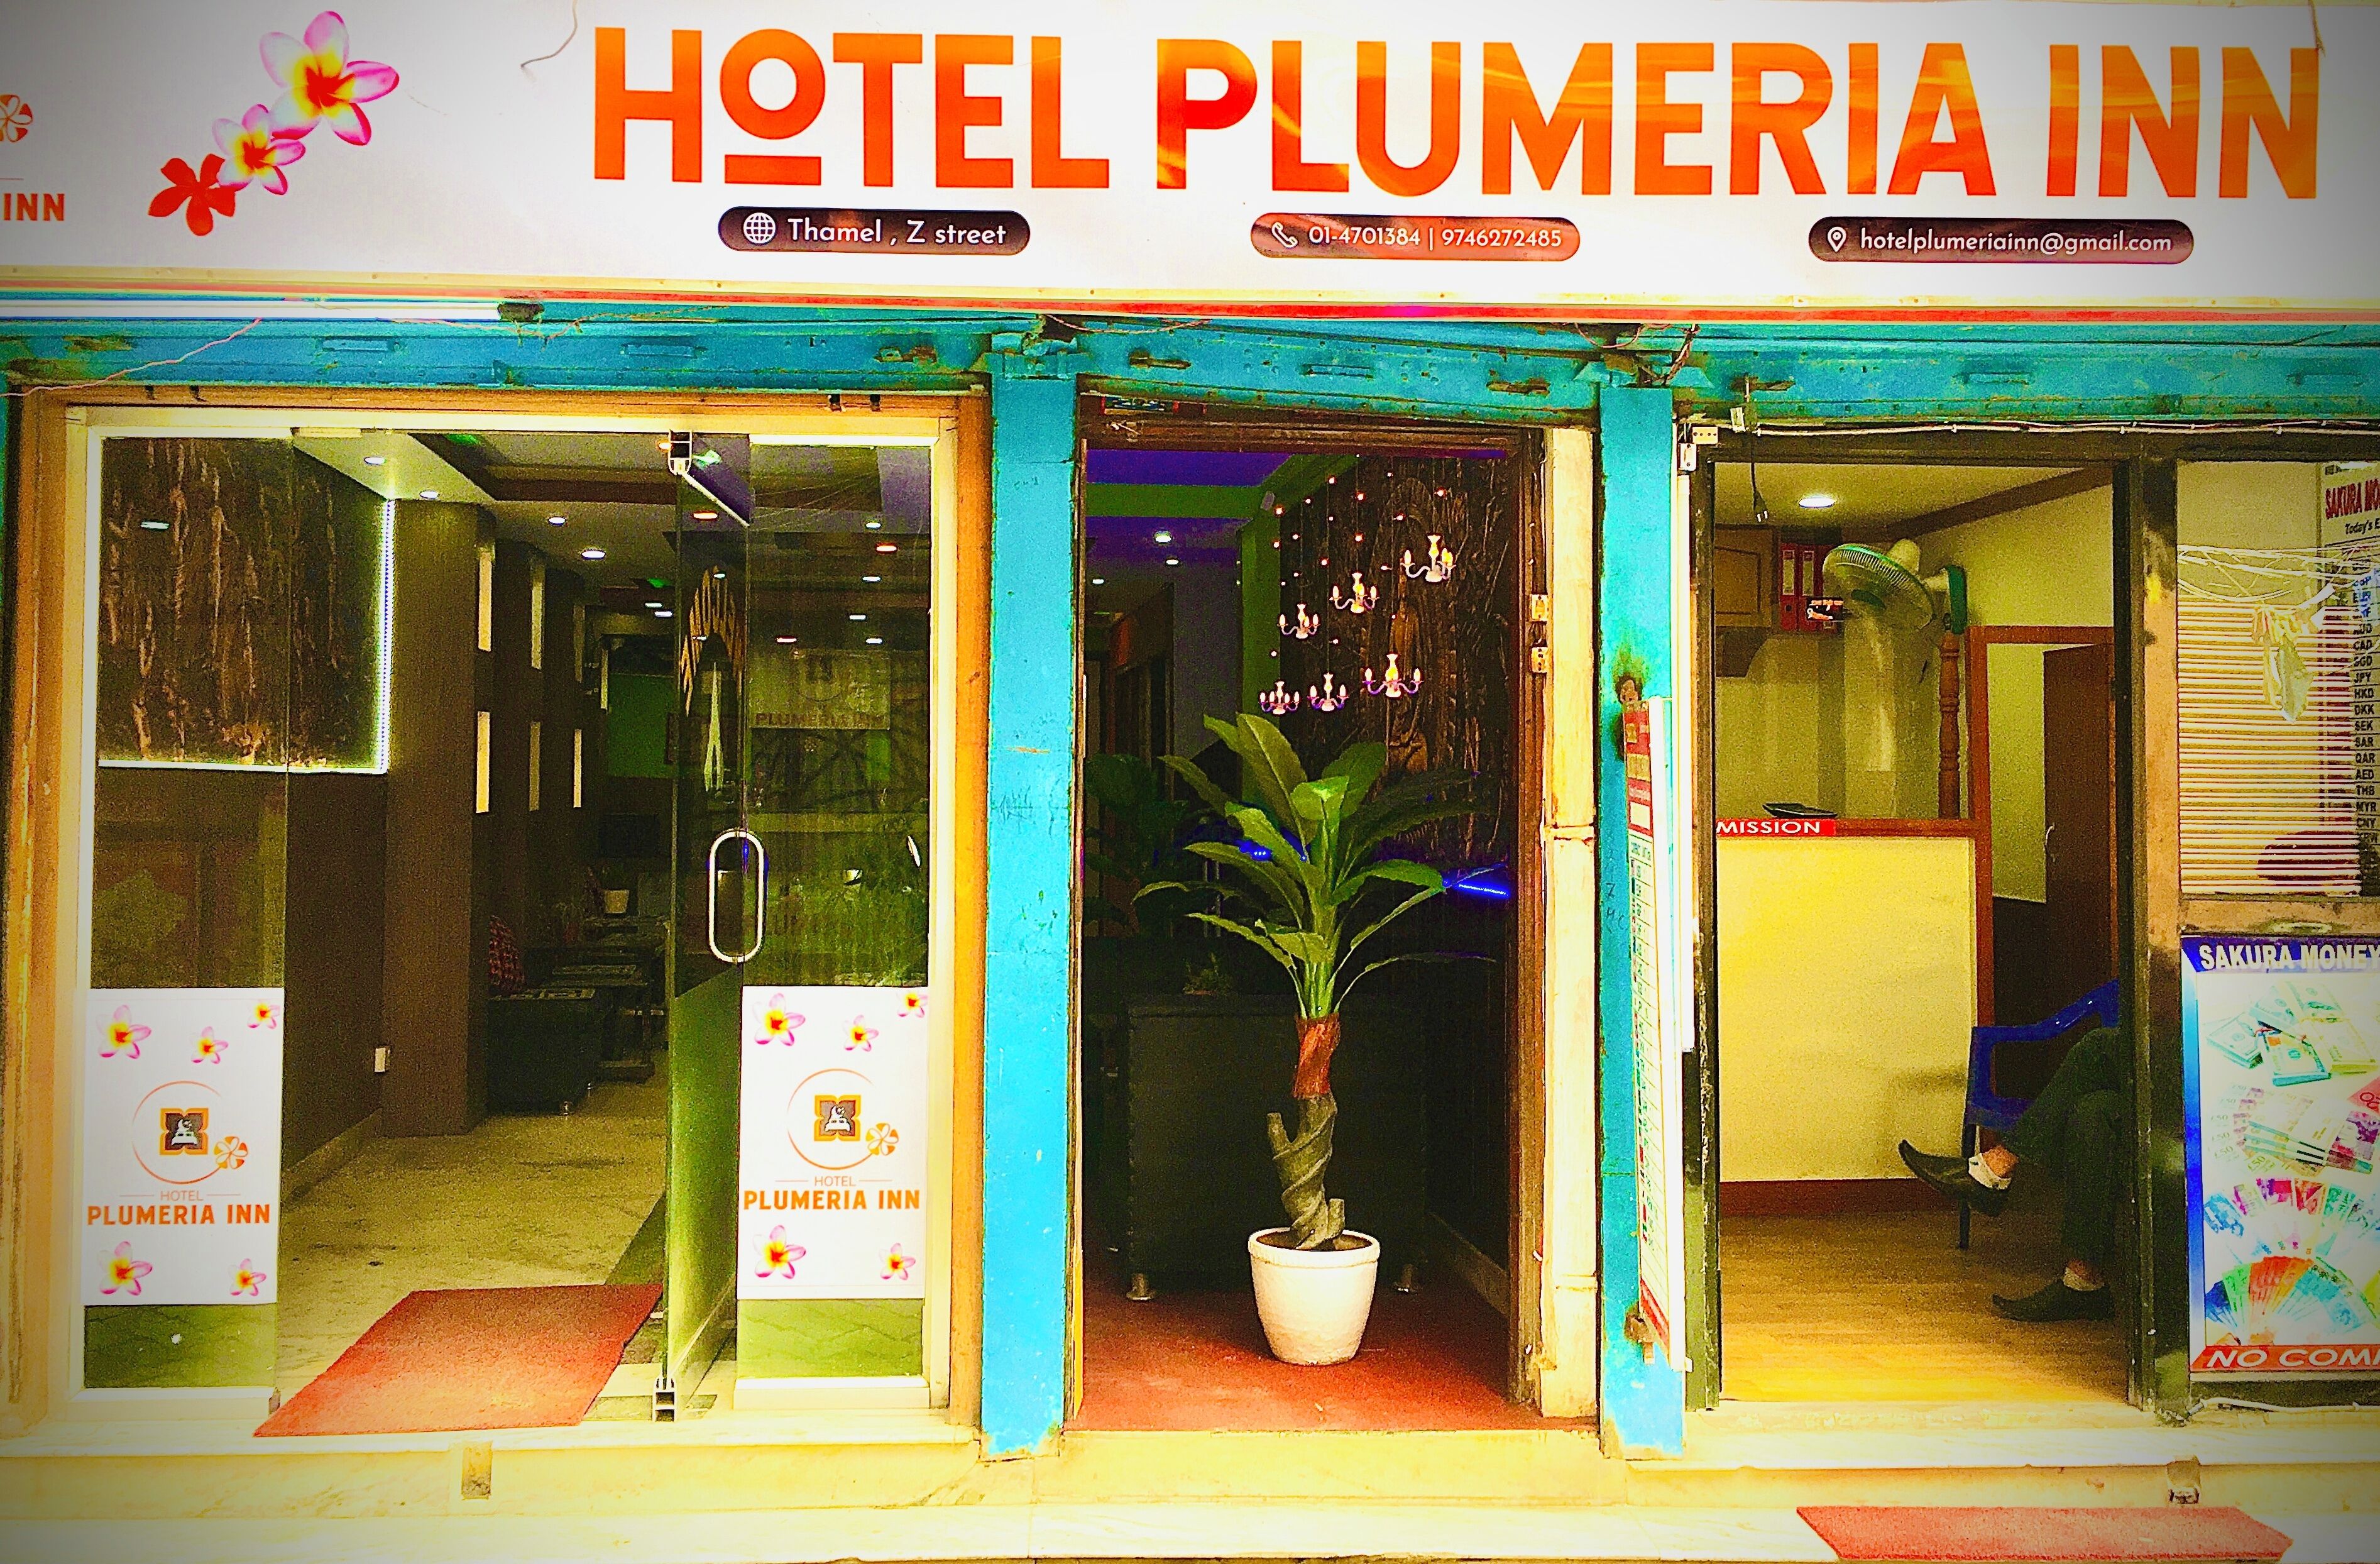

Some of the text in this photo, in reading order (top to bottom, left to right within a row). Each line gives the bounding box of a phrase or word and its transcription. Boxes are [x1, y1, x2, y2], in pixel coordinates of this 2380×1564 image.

[595, 27, 2320, 199] HOTEL PLUMERIA INN
[3, 192, 65, 221] INN
[788, 217, 881, 243] Thamel
[906, 220, 925, 244] Z
[935, 224, 1007, 245] street
[1308, 225, 1562, 248] 01-4701384 9746272485
[1860, 228, 2173, 255] hotelplumeriainn@gmail.com
[2365, 479, 2380, 512] MO
[2355, 769, 2374, 779] AED
[1716, 821, 1820, 834] MISSION
[2199, 944, 2380, 970] SAKURA MONEY
[814, 1176, 856, 1187] HOTEL
[160, 1191, 203, 1202] HOTEL
[743, 1190, 919, 1209] PLUMERIA INN
[87, 1204, 270, 1225] PLUMERIA INN
[2207, 1350, 2268, 1368] NO
